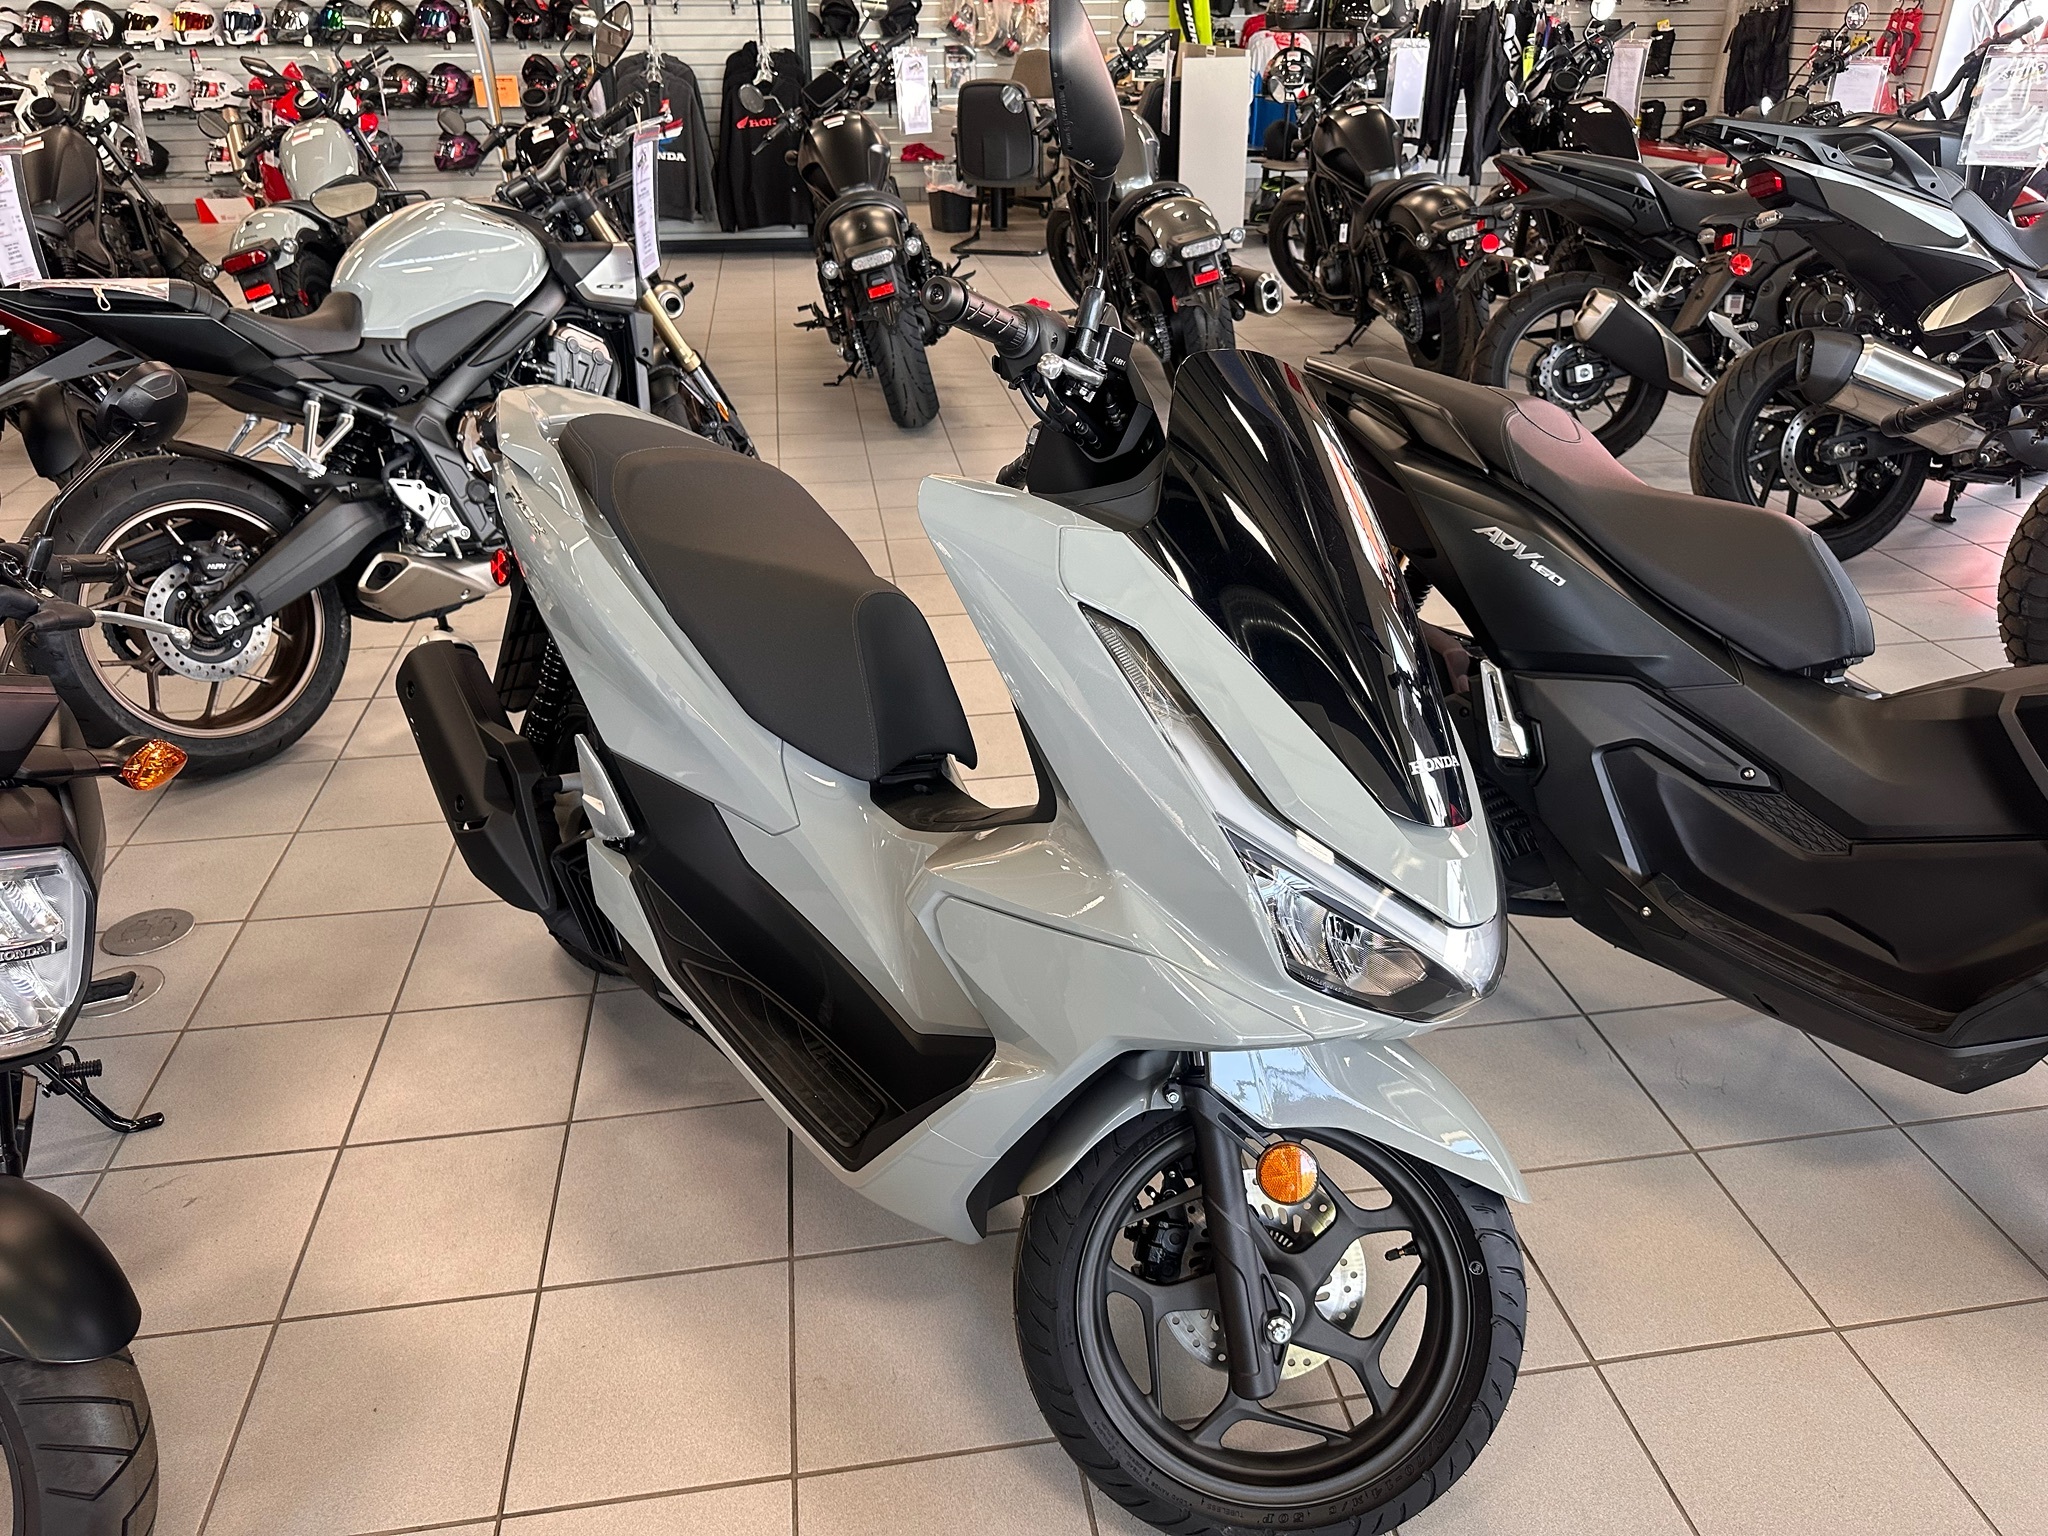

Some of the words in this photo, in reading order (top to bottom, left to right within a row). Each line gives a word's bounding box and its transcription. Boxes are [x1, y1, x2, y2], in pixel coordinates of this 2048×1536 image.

[657, 152, 686, 162] NDA
[1472, 526, 1544, 560] ADV
[1529, 559, 1566, 587] 160
[1408, 754, 1460, 776] HONDA
[1207, 1503, 1244, 1519] TUBELESS
